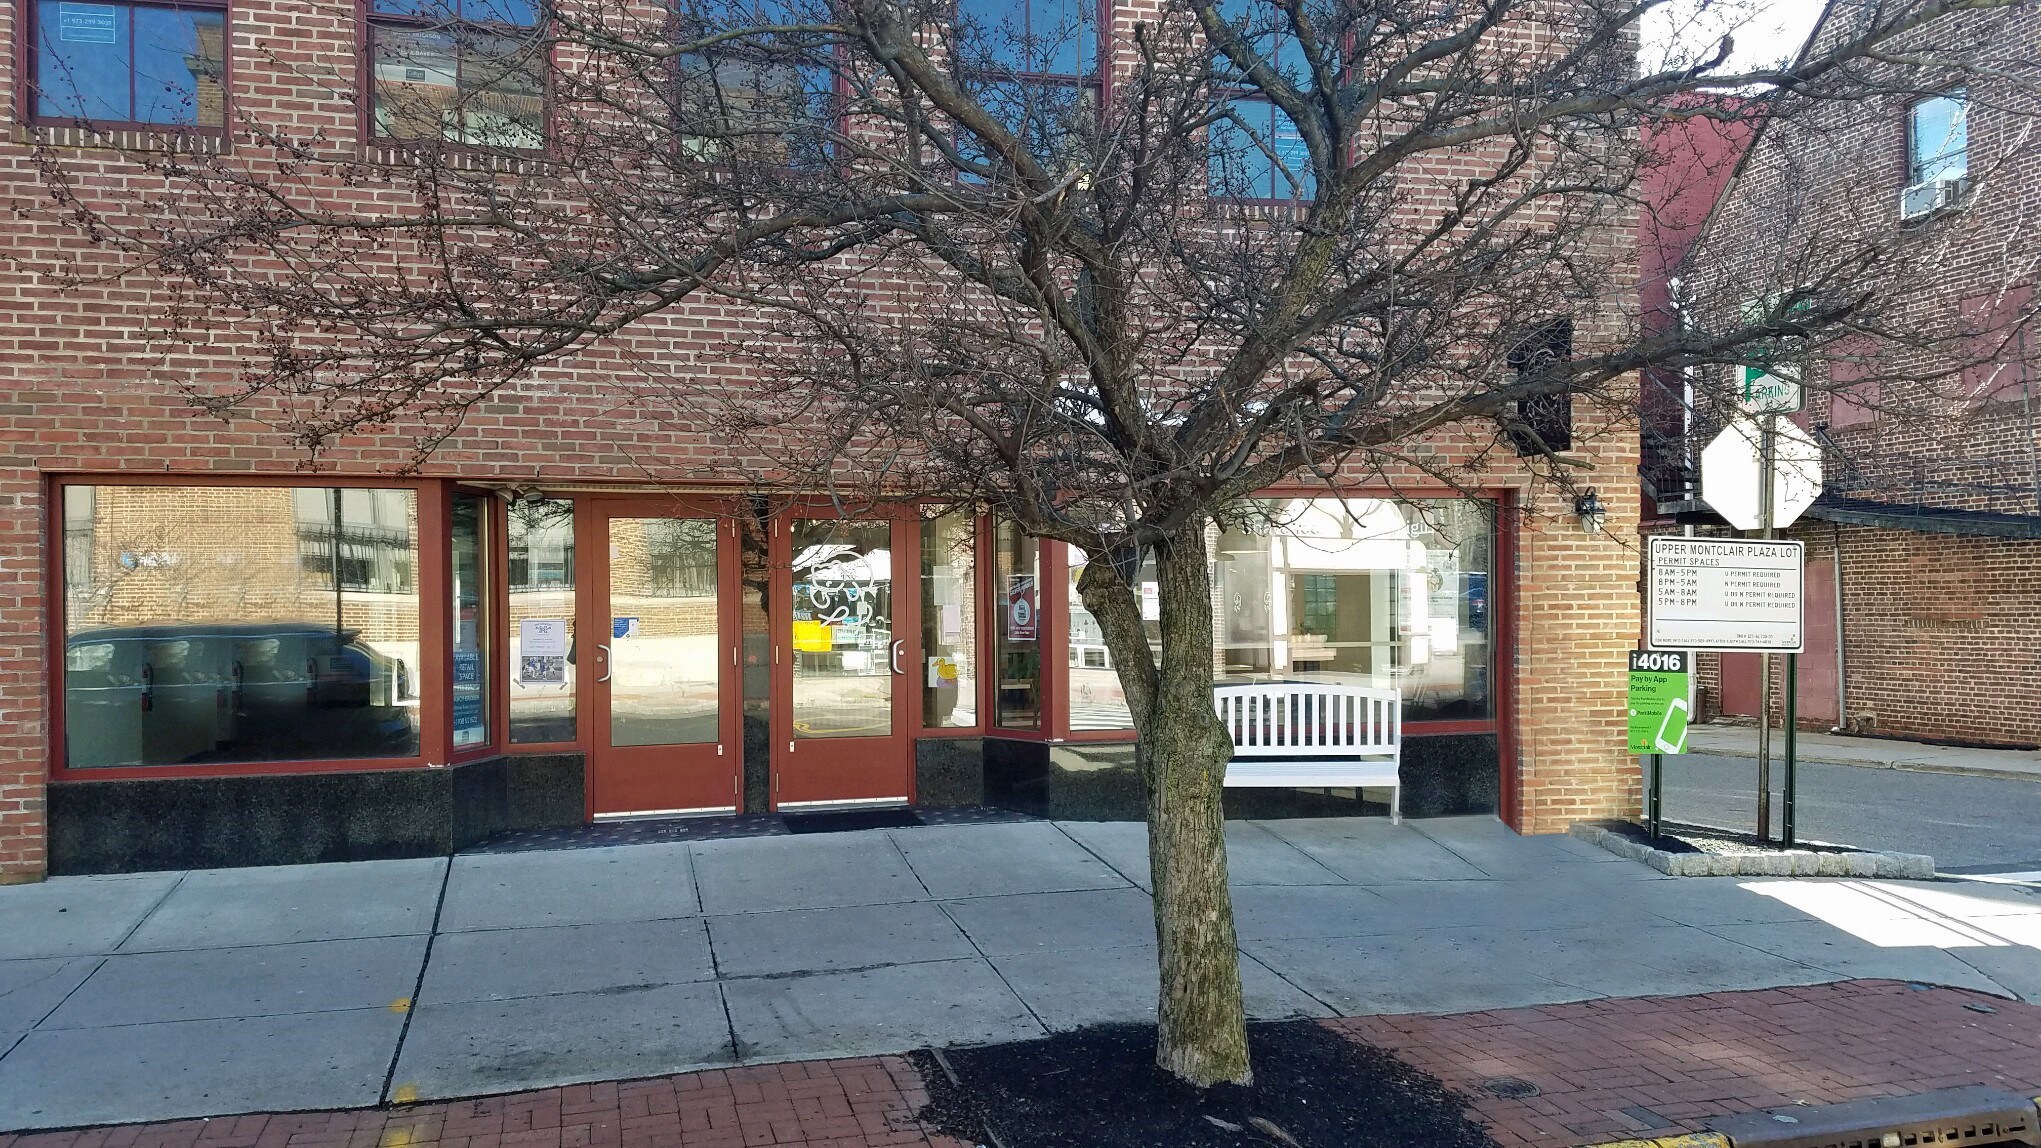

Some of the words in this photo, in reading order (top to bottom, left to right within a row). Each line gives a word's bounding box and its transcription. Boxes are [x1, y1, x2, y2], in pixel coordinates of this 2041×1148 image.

[1655, 543, 1687, 555] UPPER
[1690, 544, 1745, 557] MONTCLAIR
[1747, 546, 1778, 558] PLAZA
[1780, 547, 1798, 558] LOT
[1658, 557, 1686, 565] PERMIT
[1689, 557, 1720, 566] SPACES
[1630, 674, 1643, 683] Pay
[1644, 675, 1653, 683] by
[1654, 675, 1668, 684] App
[1630, 684, 1657, 693] Parking
